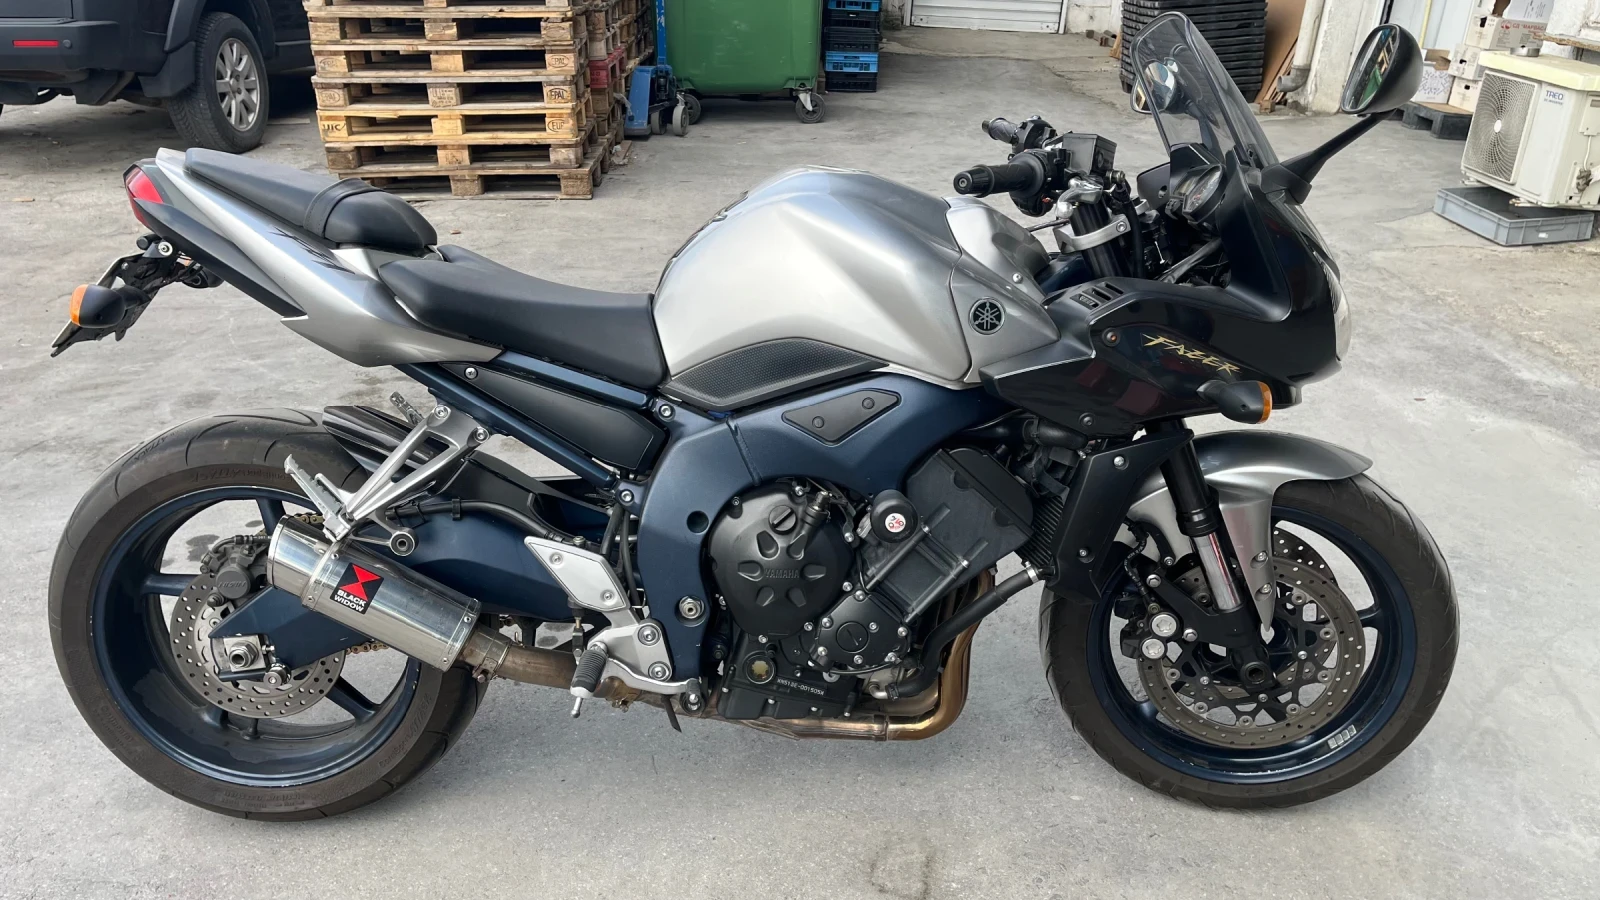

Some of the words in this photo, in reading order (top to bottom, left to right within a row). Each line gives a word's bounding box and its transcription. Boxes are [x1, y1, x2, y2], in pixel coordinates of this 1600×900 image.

[550, 90, 565, 100] EPAL
[1142, 333, 1241, 376] FAZER
[765, 568, 800, 579] YAMAHA
[334, 594, 364, 612] WIDOW
[337, 589, 367, 607] BLACK
